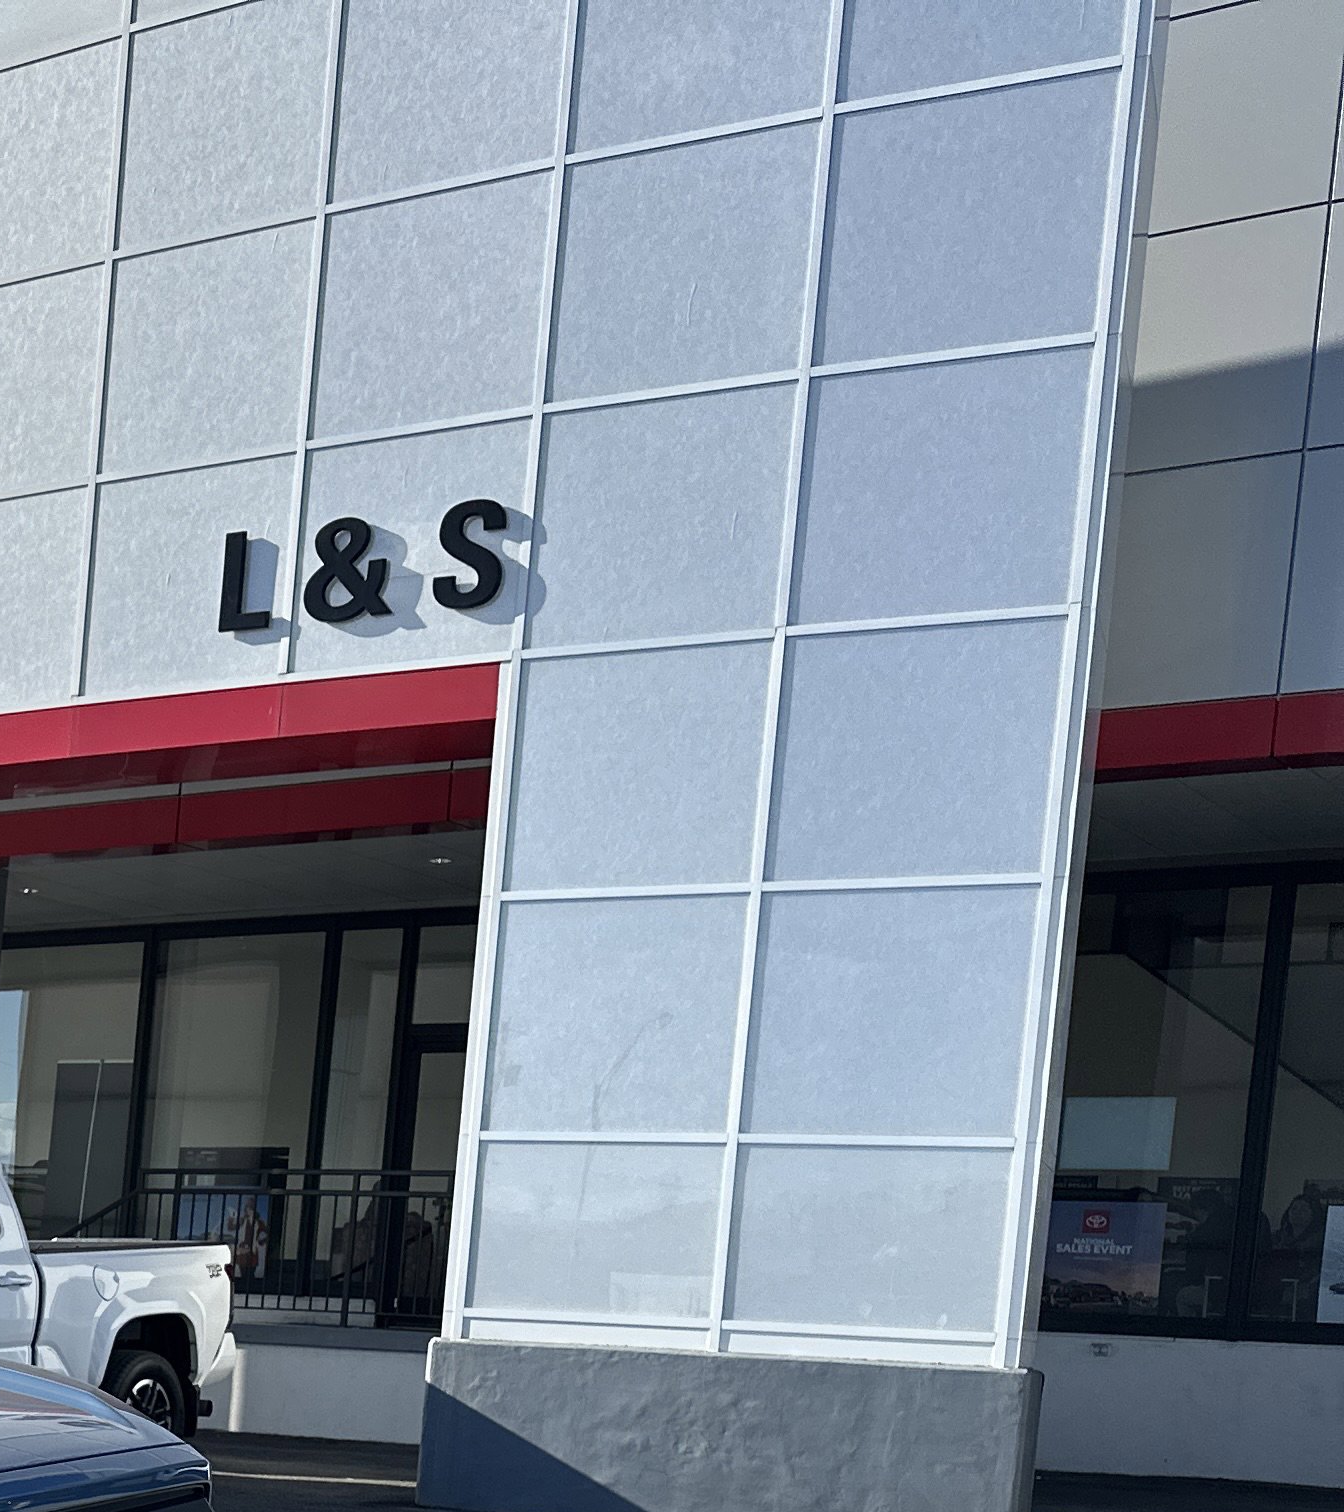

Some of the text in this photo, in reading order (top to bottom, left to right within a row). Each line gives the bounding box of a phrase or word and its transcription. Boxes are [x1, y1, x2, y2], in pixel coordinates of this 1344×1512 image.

[1073, 1237, 1114, 1246] NATIONAL
[1056, 1243, 1132, 1255] SALES EVENT
